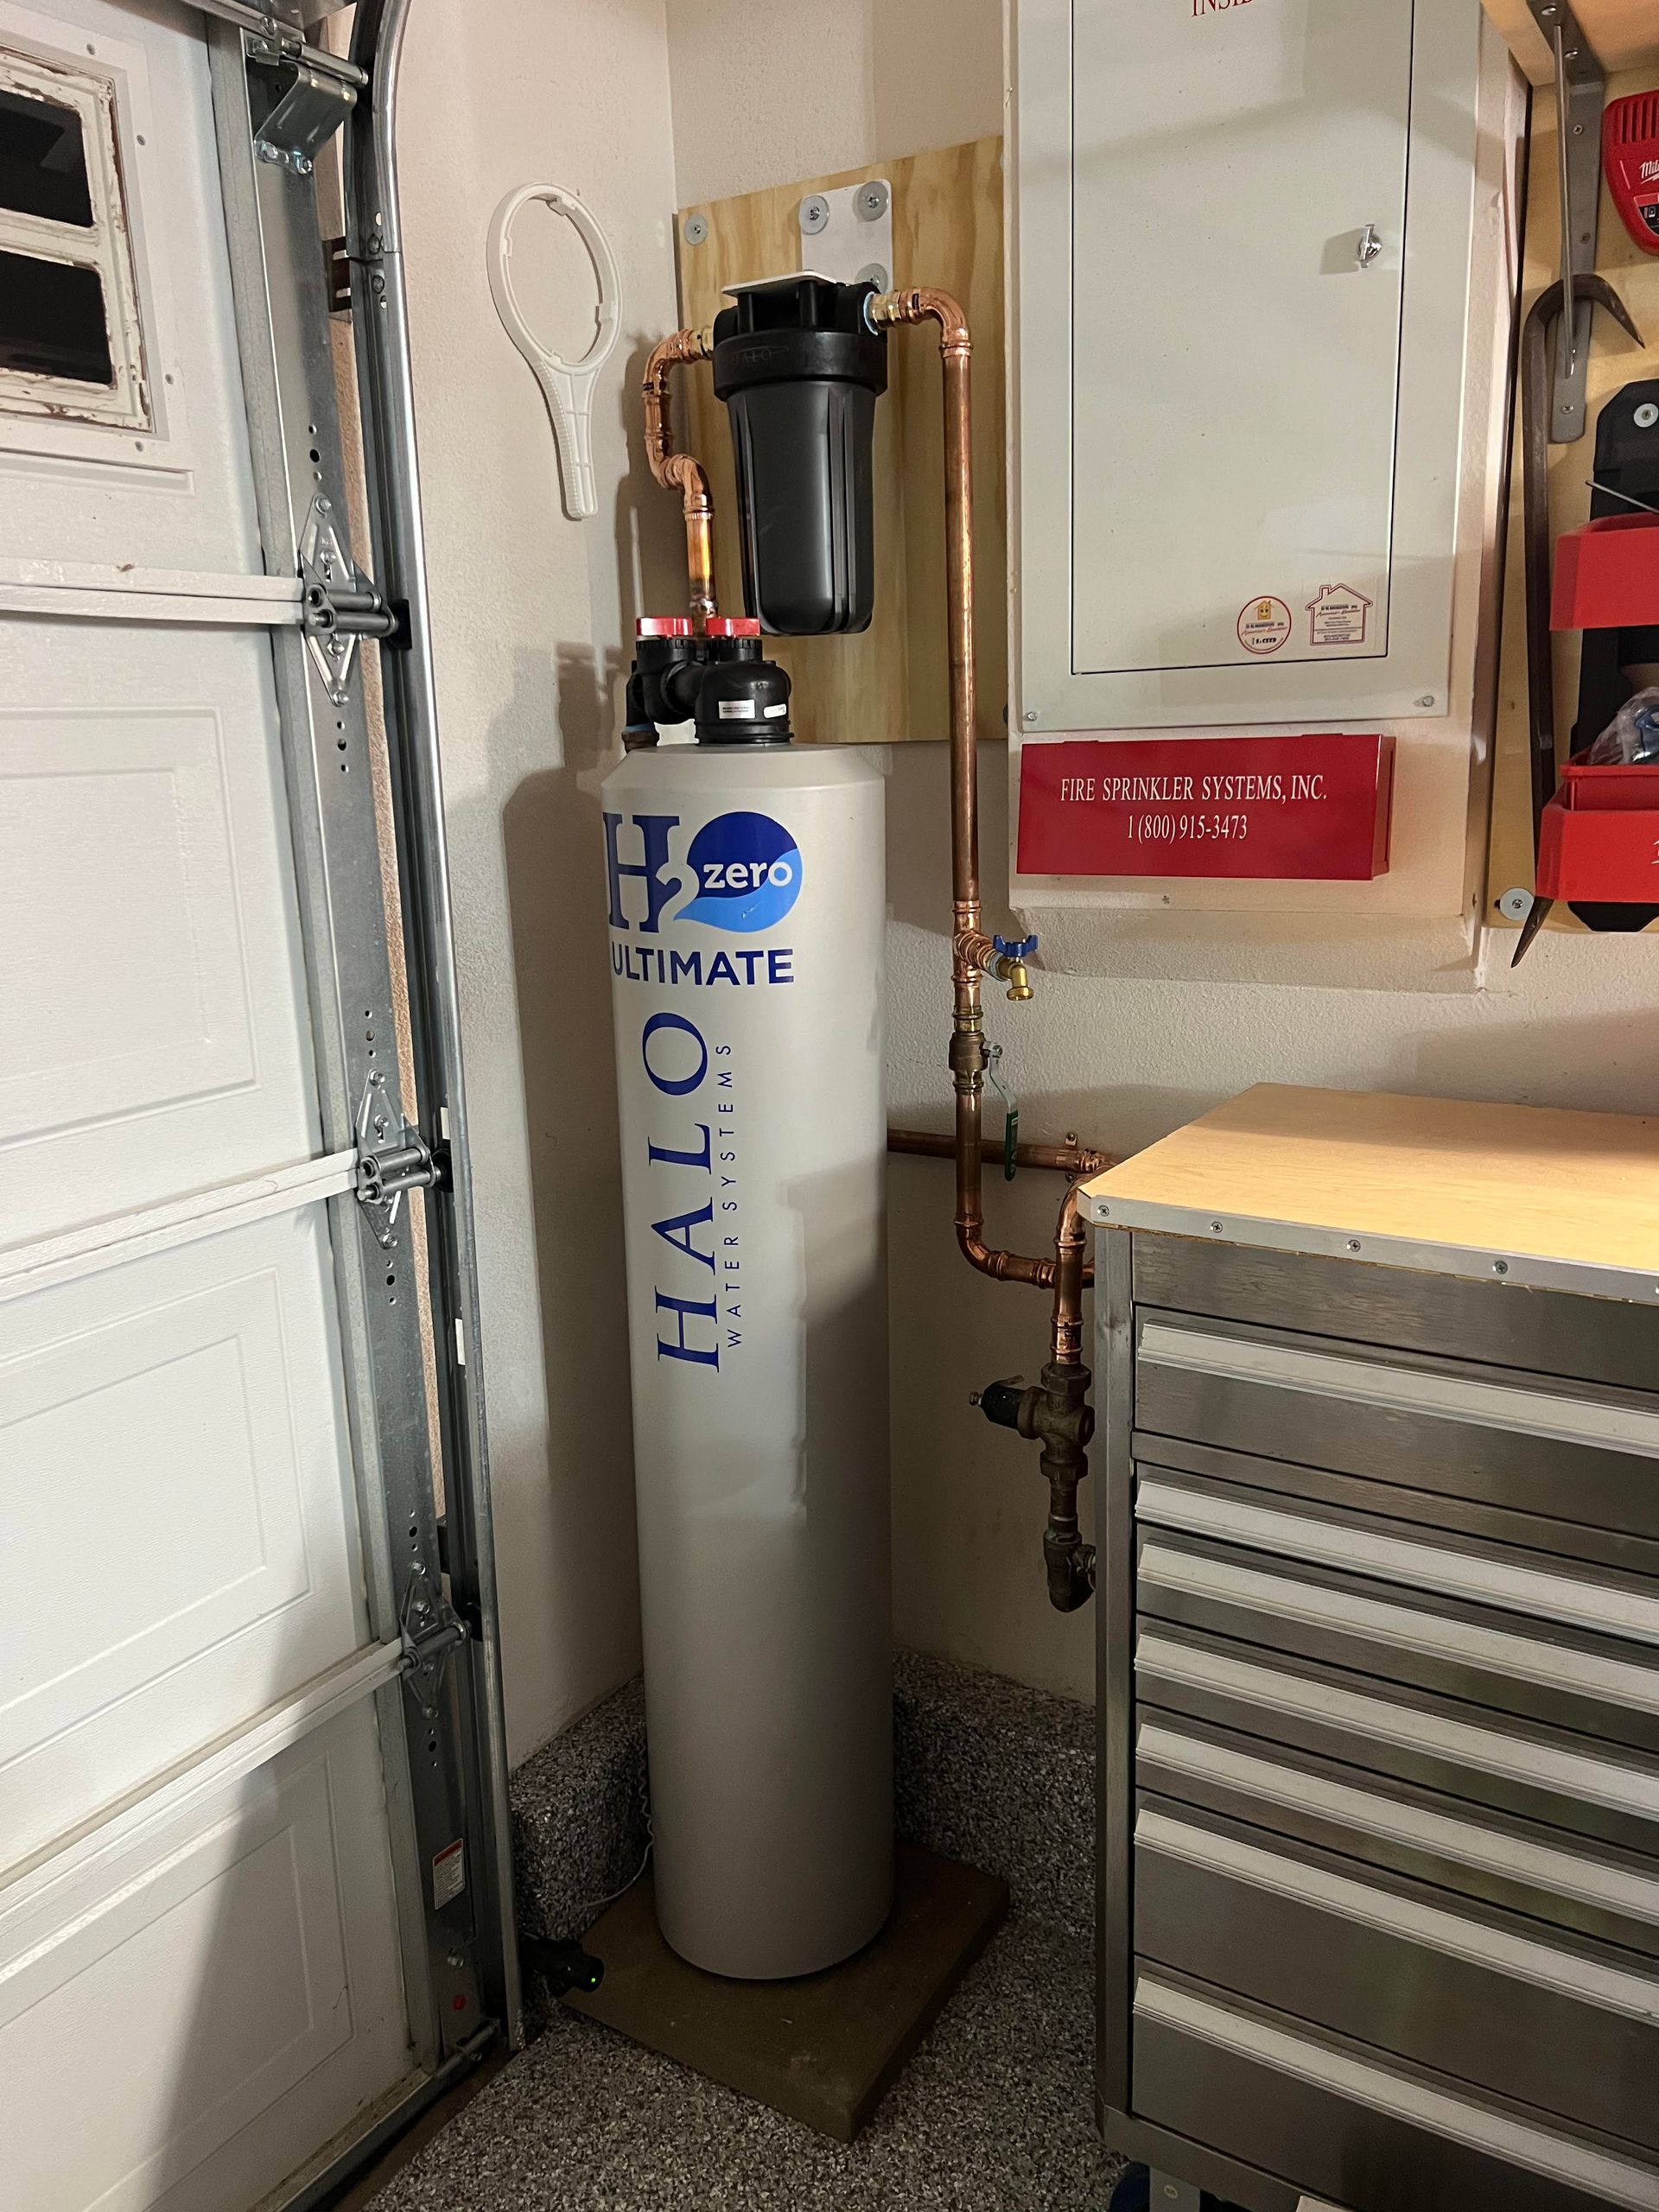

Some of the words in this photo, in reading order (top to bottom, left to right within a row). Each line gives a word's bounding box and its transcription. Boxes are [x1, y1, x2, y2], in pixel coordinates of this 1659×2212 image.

[1638, 159, 1659, 180] Mil
[1060, 777, 1096, 802] FIRE
[1103, 776, 1194, 801] SPRINKLER
[1201, 775, 1287, 804] SYSTEMS,
[1290, 774, 1328, 800] INC.
[1128, 815, 1134, 839] 1
[1138, 814, 1176, 844] (800)
[1179, 814, 1248, 840] 915-3473
[703, 861, 793, 889] zero
[612, 940, 795, 986] ULTIMATE
[715, 1044, 738, 1211] SYSTEMS
[642, 1012, 720, 1373] HALO
[724, 1235, 743, 1348] WATER
